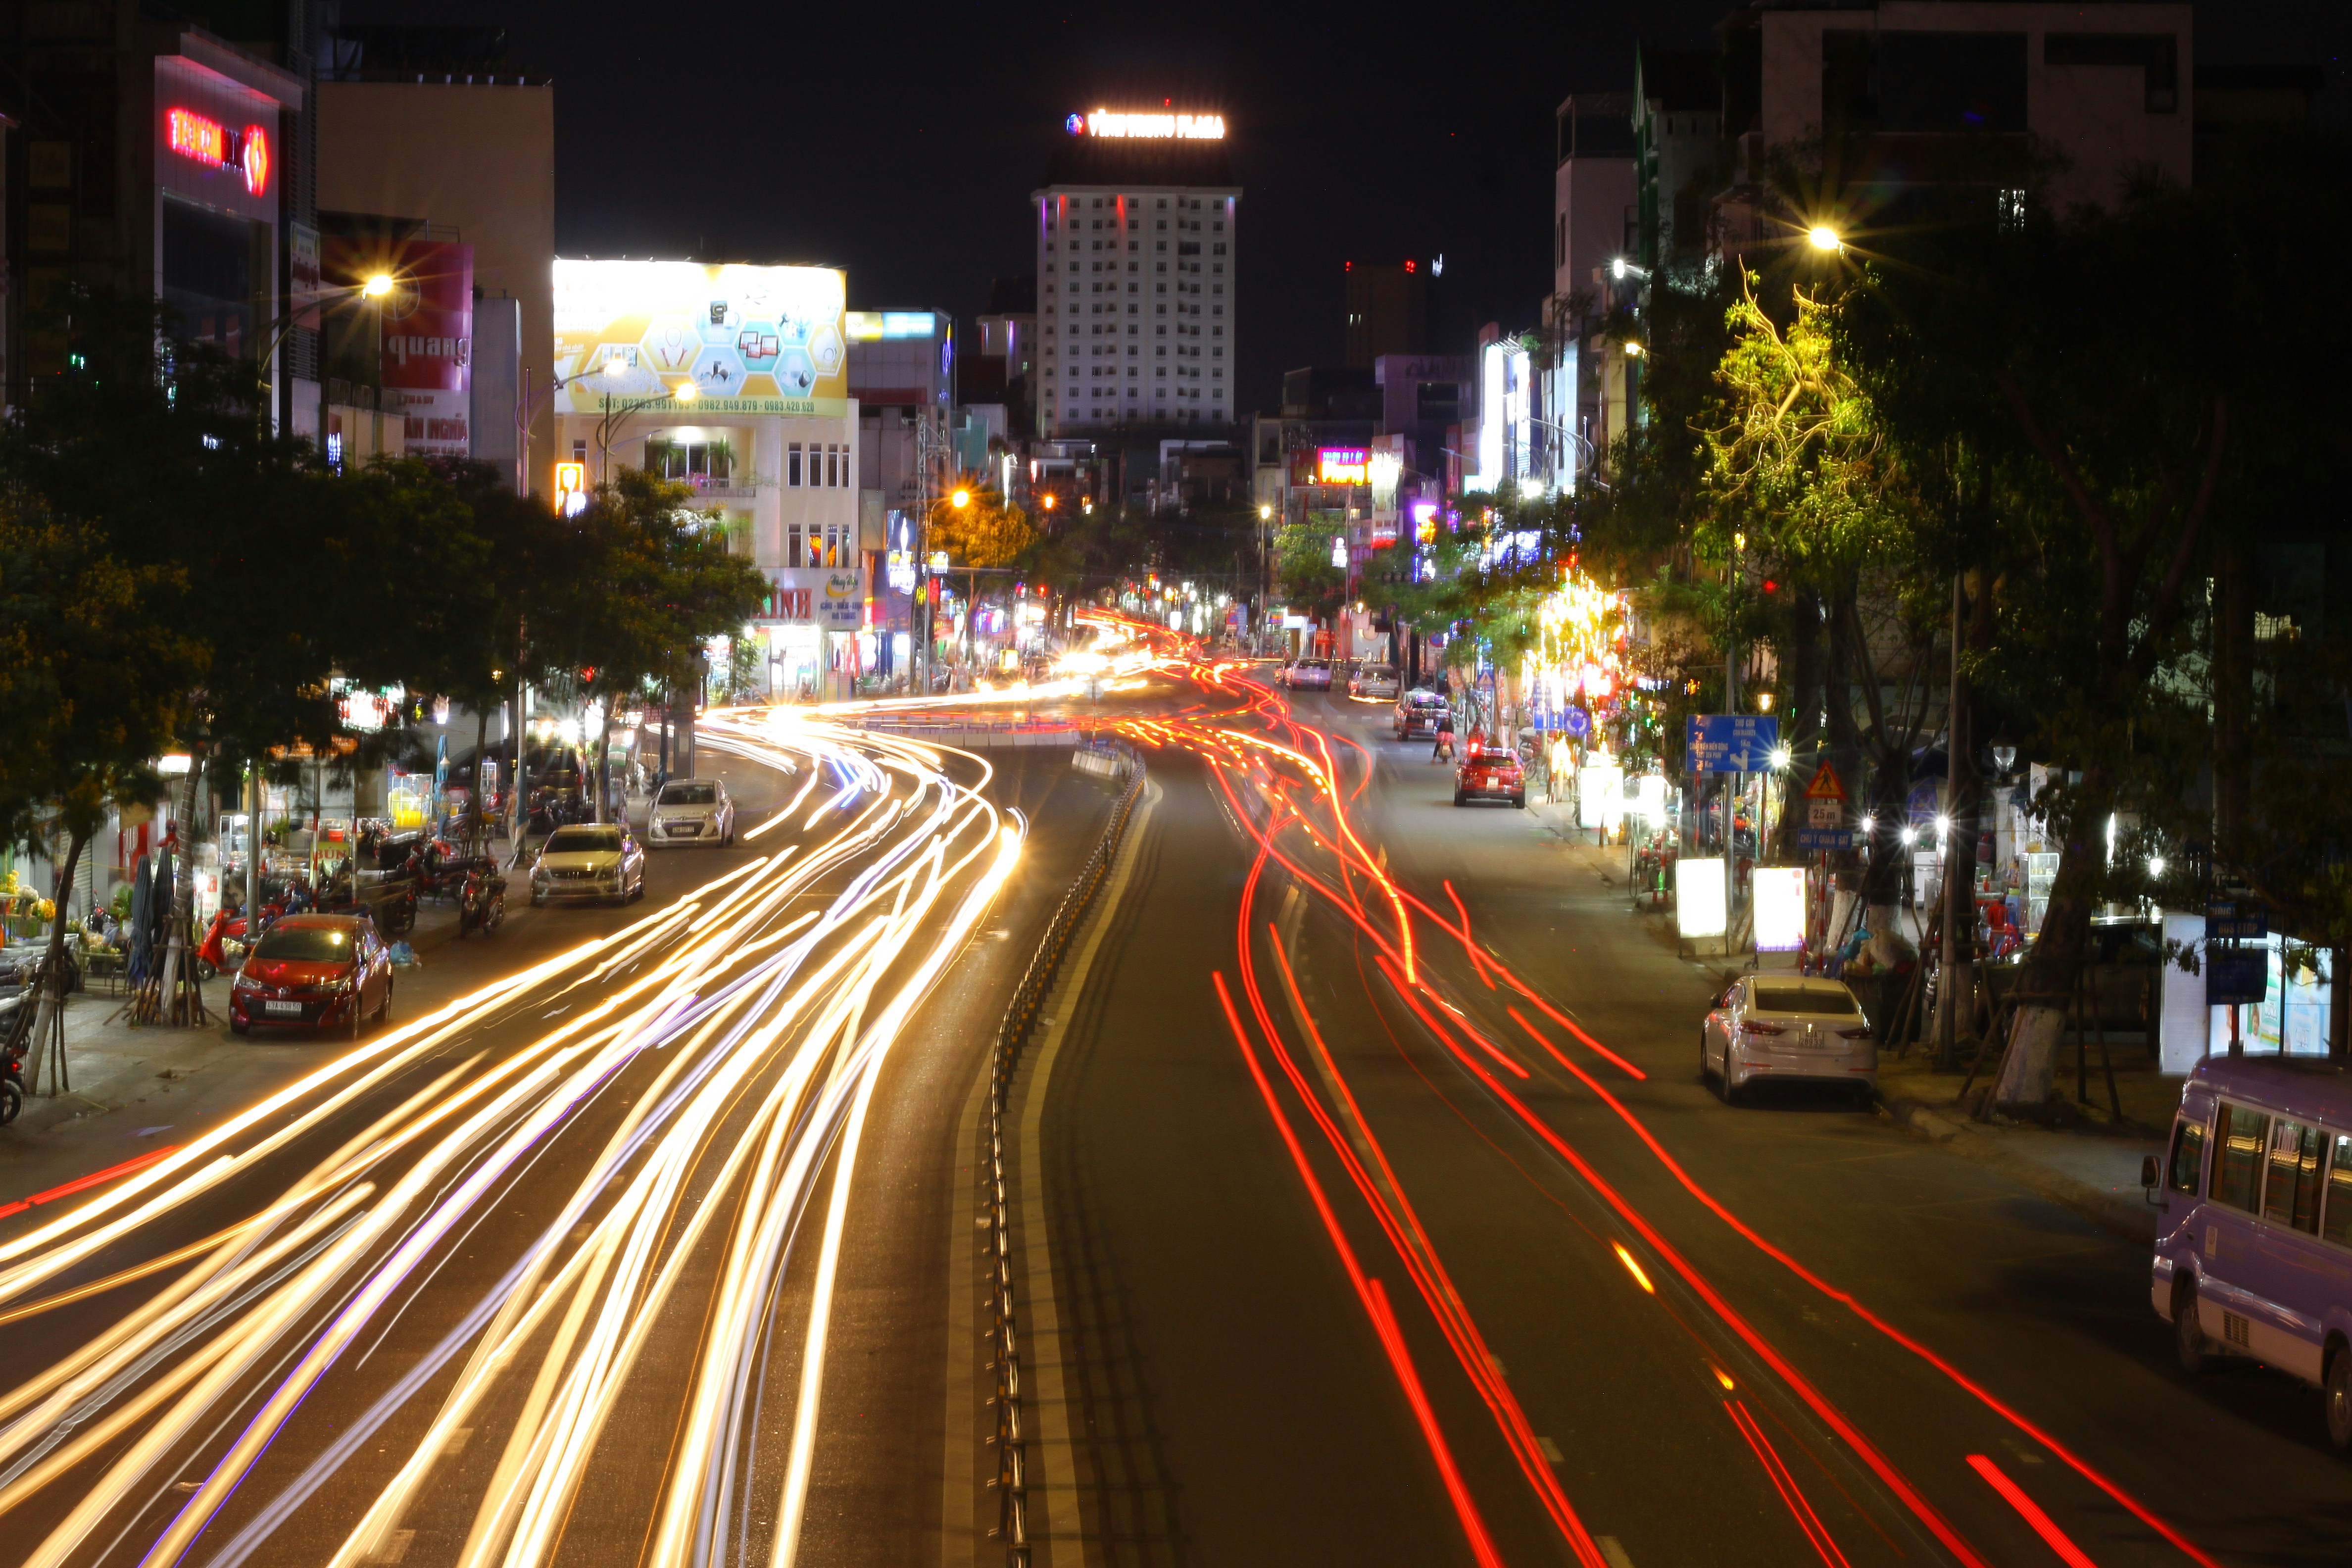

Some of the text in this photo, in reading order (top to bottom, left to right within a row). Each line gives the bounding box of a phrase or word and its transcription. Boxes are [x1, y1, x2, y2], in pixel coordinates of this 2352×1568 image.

[389, 335, 470, 367] quang
[698, 399, 757, 410] 0982.949.879
[765, 400, 814, 412] 0983.420.620
[1813, 809, 1824, 819] 25
